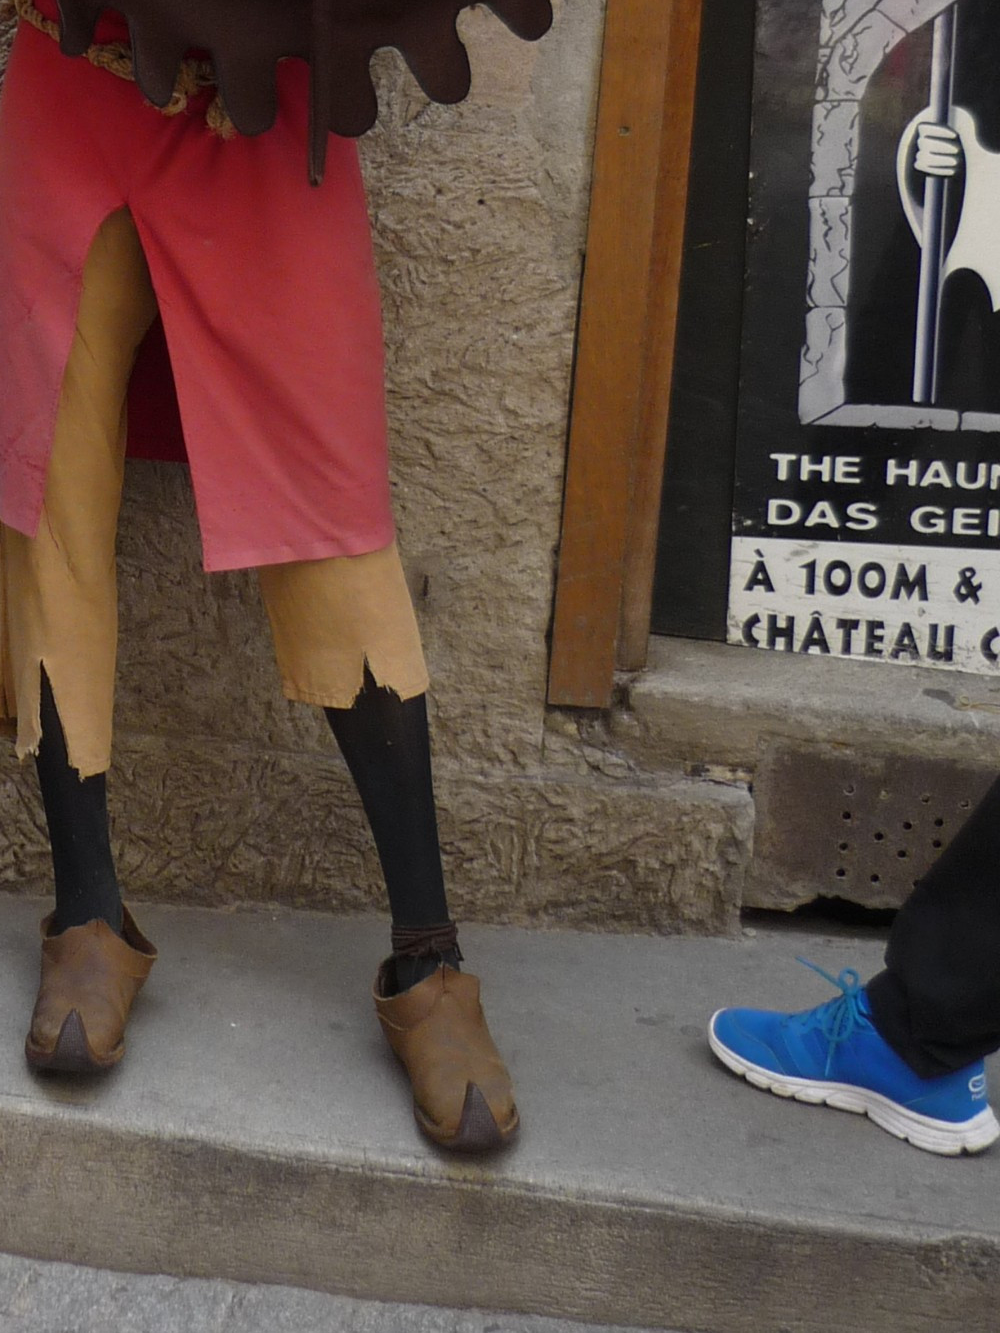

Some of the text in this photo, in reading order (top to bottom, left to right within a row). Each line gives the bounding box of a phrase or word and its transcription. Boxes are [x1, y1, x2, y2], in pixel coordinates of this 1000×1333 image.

[769, 453, 862, 484] THE
[767, 499, 879, 530] DAS
[743, 548, 983, 606] À 100M &
[741, 610, 956, 663] CHÂTEAU
